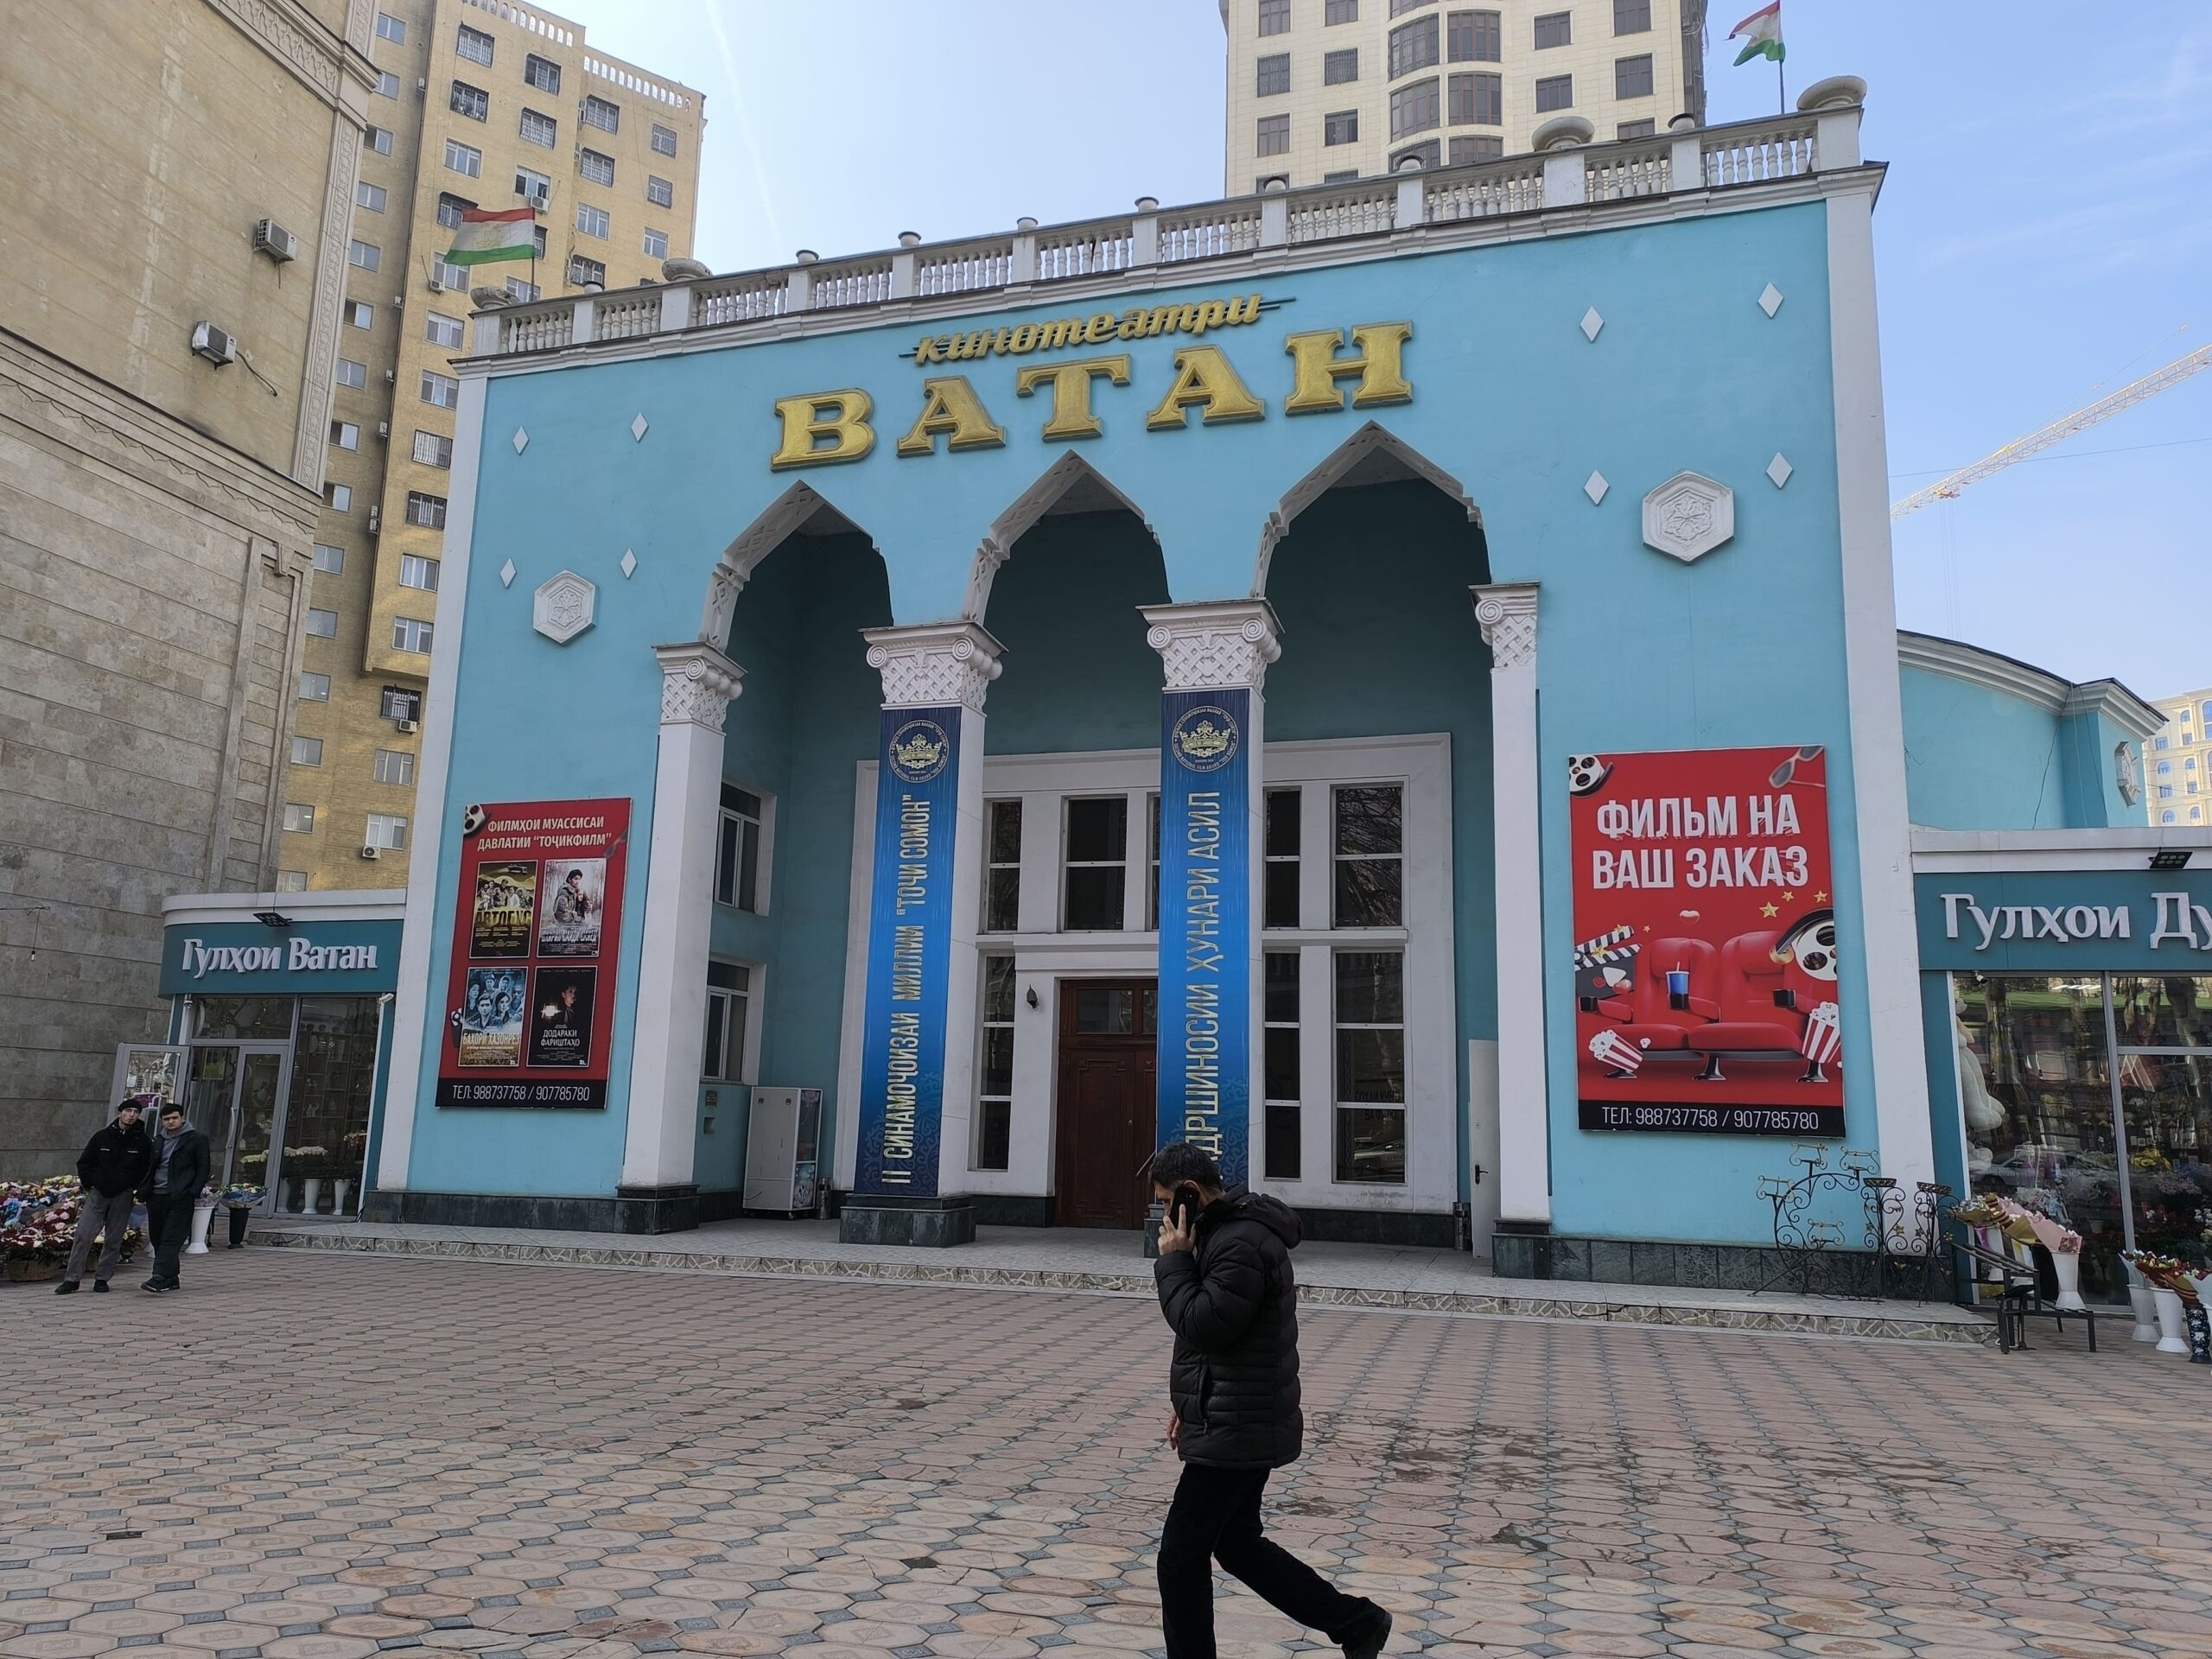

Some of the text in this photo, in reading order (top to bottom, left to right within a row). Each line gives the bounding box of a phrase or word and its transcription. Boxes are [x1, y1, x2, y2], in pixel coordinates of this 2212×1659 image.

[914, 292, 1263, 366] кинотеатри
[770, 320, 1414, 472] ВАТАН
[487, 816, 605, 833] ФИЛМҲОИ МУАССИСАИ
[899, 794, 931, 859] СОМОН"
[1187, 791, 1221, 860] АСИЛ
[1597, 794, 1801, 839] ФИЛЬМ НА
[477, 836, 531, 851] ДАВЛАТИИ
[1592, 845, 1808, 889] ВАШ ЗАКАЗ
[1940, 893, 2131, 950] Гулҳои
[181, 938, 378, 979] Гулҳои Ватан
[892, 925, 925, 1001] МИЛЛИИ
[543, 1029, 577, 1038] ДОДАРАКИ
[453, 1085, 590, 1101] ТЕЛ: 988737758 / 907785780
[1185, 984, 1224, 1180] ДРШИНОСИИ
[1602, 1107, 1819, 1129] ТЕЛ: 988737758 / 907785780
